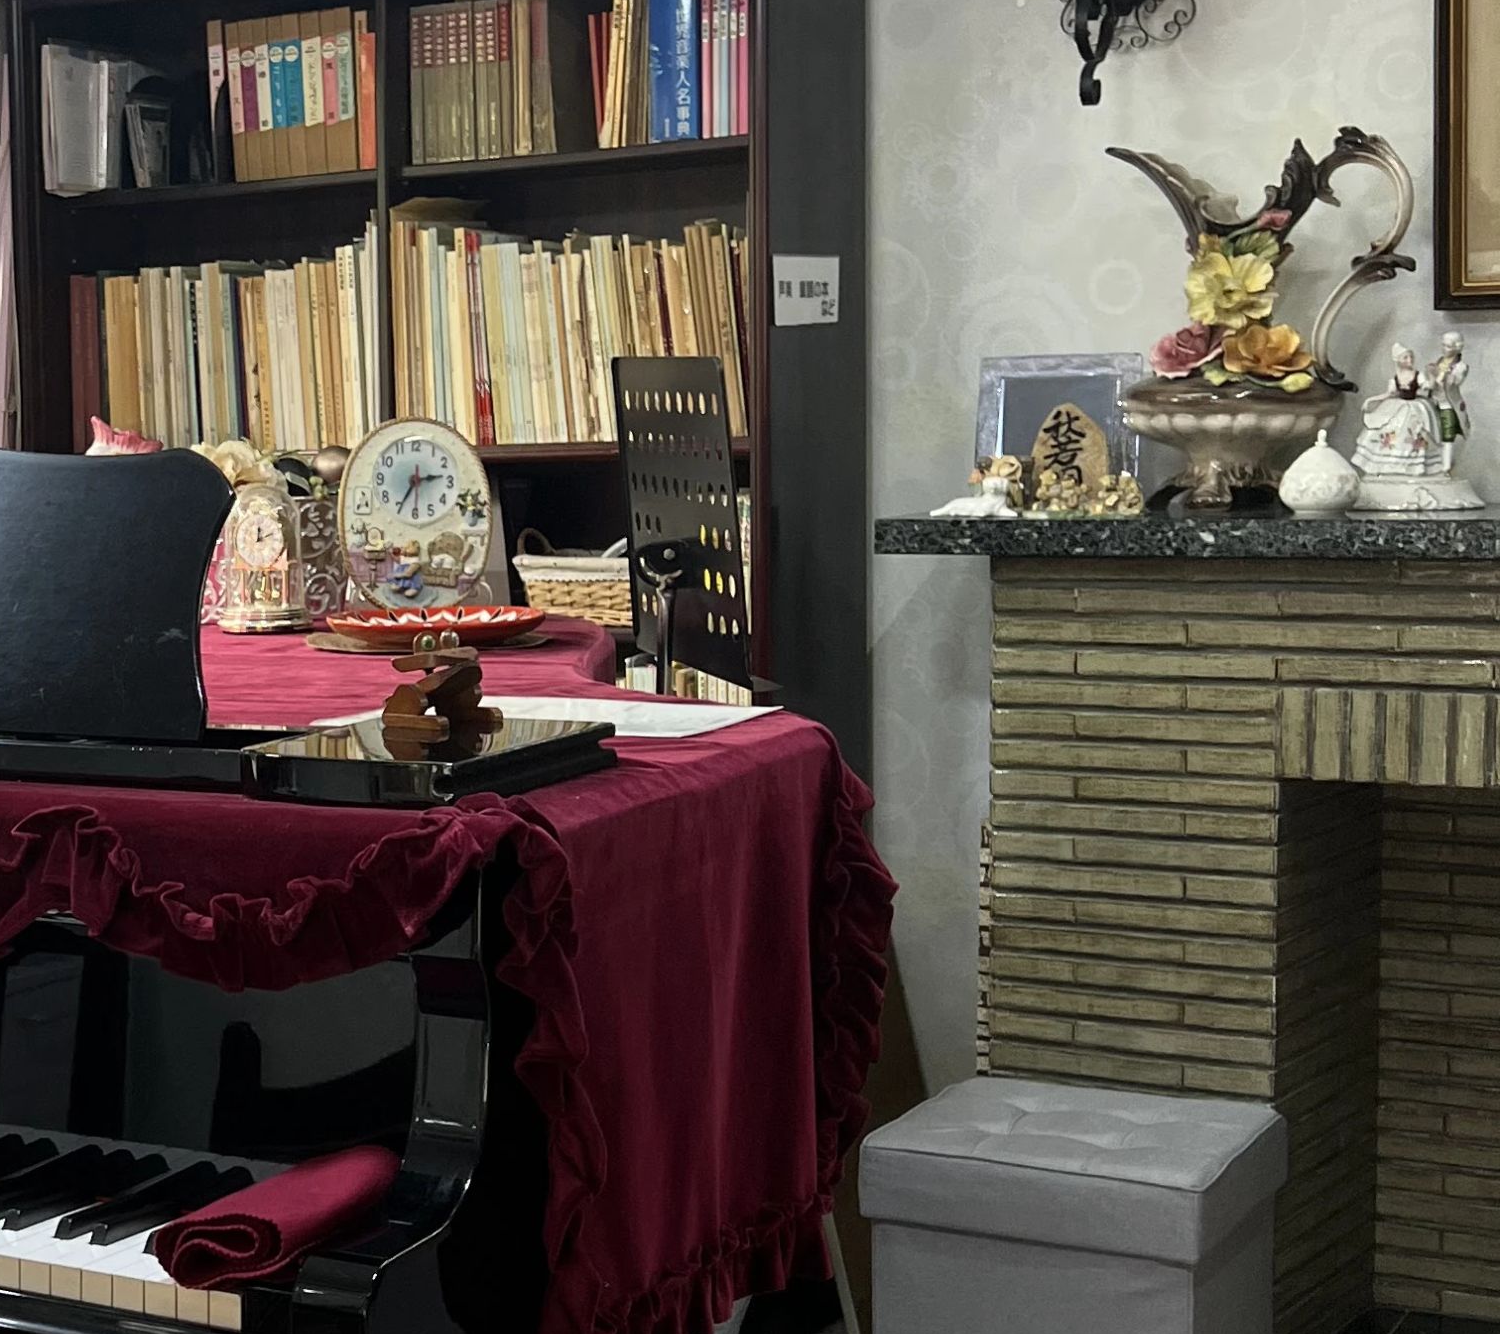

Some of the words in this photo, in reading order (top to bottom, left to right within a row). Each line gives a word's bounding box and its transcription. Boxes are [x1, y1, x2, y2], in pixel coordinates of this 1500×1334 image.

[395, 443, 404, 455] 11
[411, 441, 421, 452] 12
[431, 445, 435, 457] 1
[381, 455, 393, 468] 10
[440, 457, 448, 469] 2
[376, 472, 385, 486] 9
[446, 475, 454, 489] 3
[381, 490, 389, 503] 8
[439, 493, 446, 505] 4
[395, 501, 403, 515] 7
[411, 508, 419, 519] 6
[427, 504, 435, 517] 5
